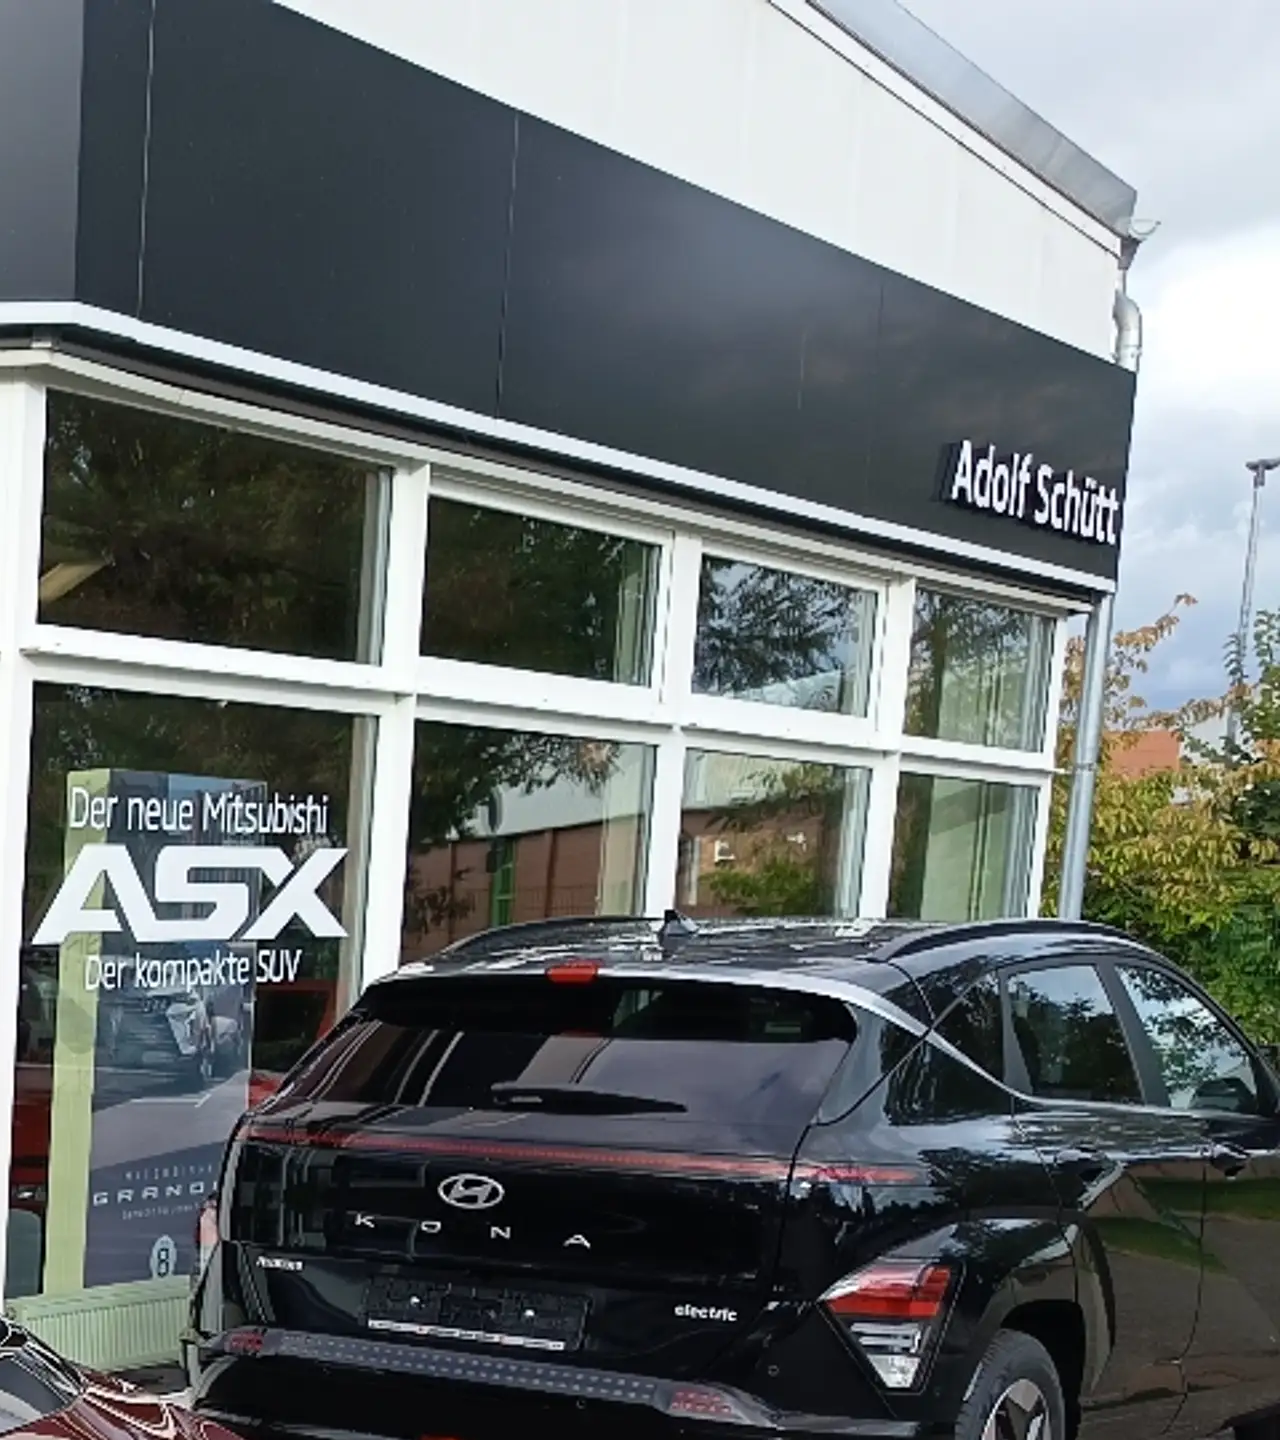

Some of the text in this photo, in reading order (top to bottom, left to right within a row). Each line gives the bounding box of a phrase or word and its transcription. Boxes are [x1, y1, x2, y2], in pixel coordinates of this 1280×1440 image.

[952, 440, 1120, 545] Adolf Schütt
[69, 786, 329, 834] Der neue Mitsubishi
[31, 843, 350, 945] ASX
[85, 949, 302, 993] Der kompakte SUV
[355, 1213, 591, 1249] KONA
[674, 1303, 738, 1322] electric
